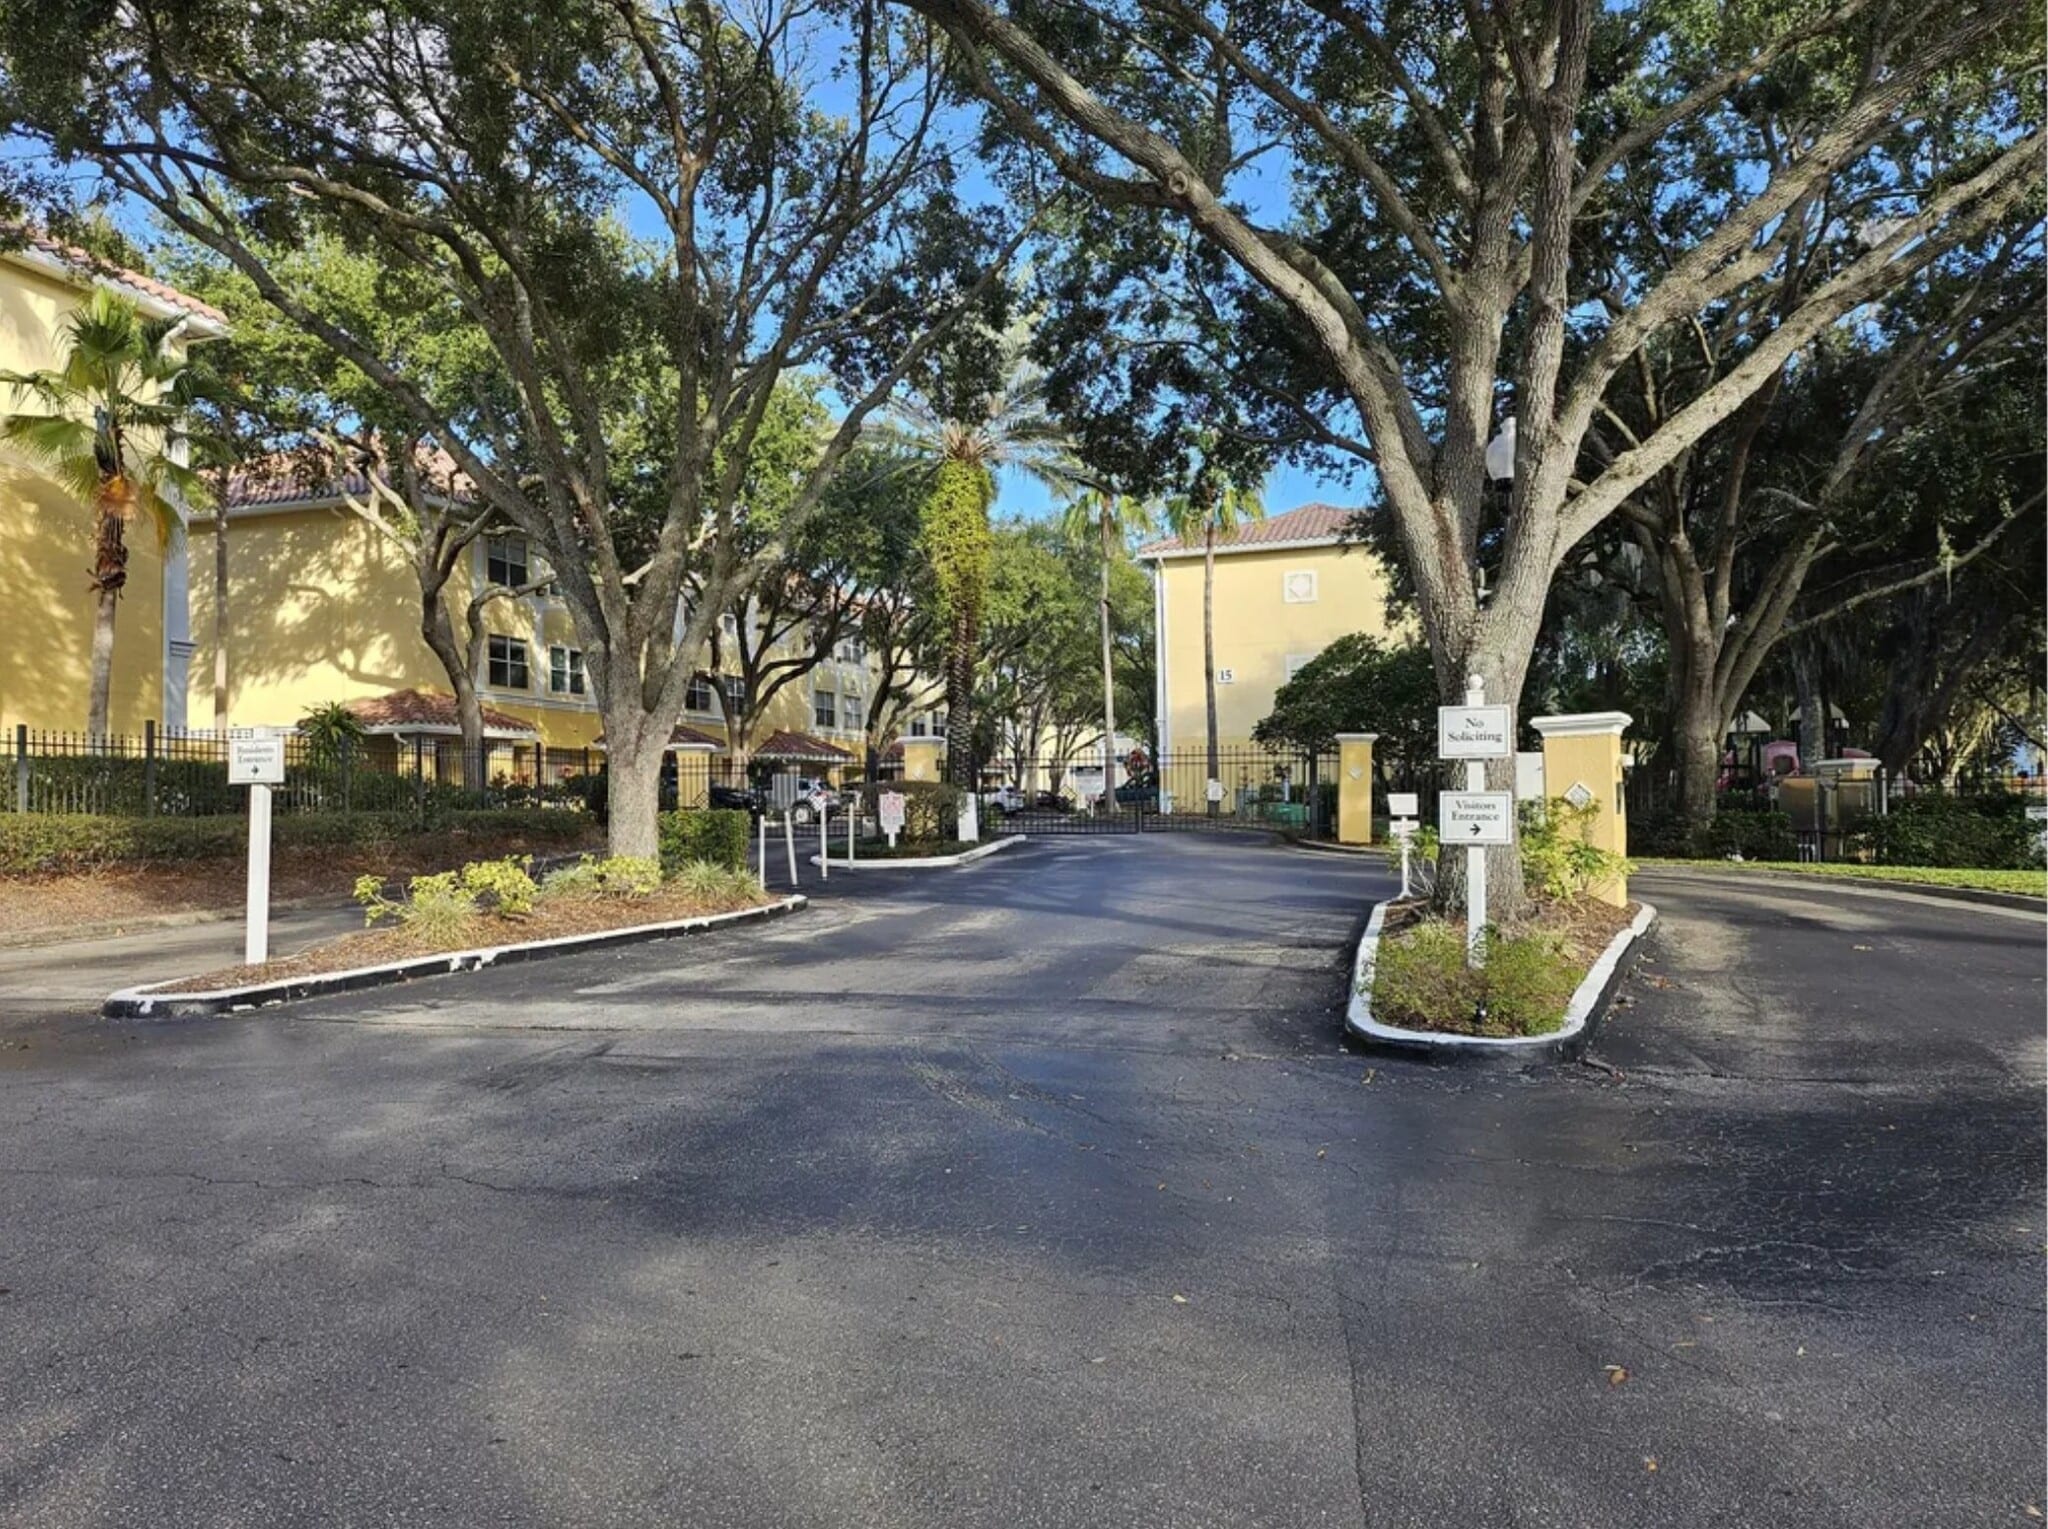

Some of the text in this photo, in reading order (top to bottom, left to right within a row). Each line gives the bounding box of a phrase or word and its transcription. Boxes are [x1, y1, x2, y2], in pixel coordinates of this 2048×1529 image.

[1221, 669, 1232, 681] 15
[1465, 717, 1485, 729] No
[1447, 730, 1503, 743] Soliciting
[1455, 800, 1496, 810] Visitors
[1451, 811, 1501, 821] Entrance
